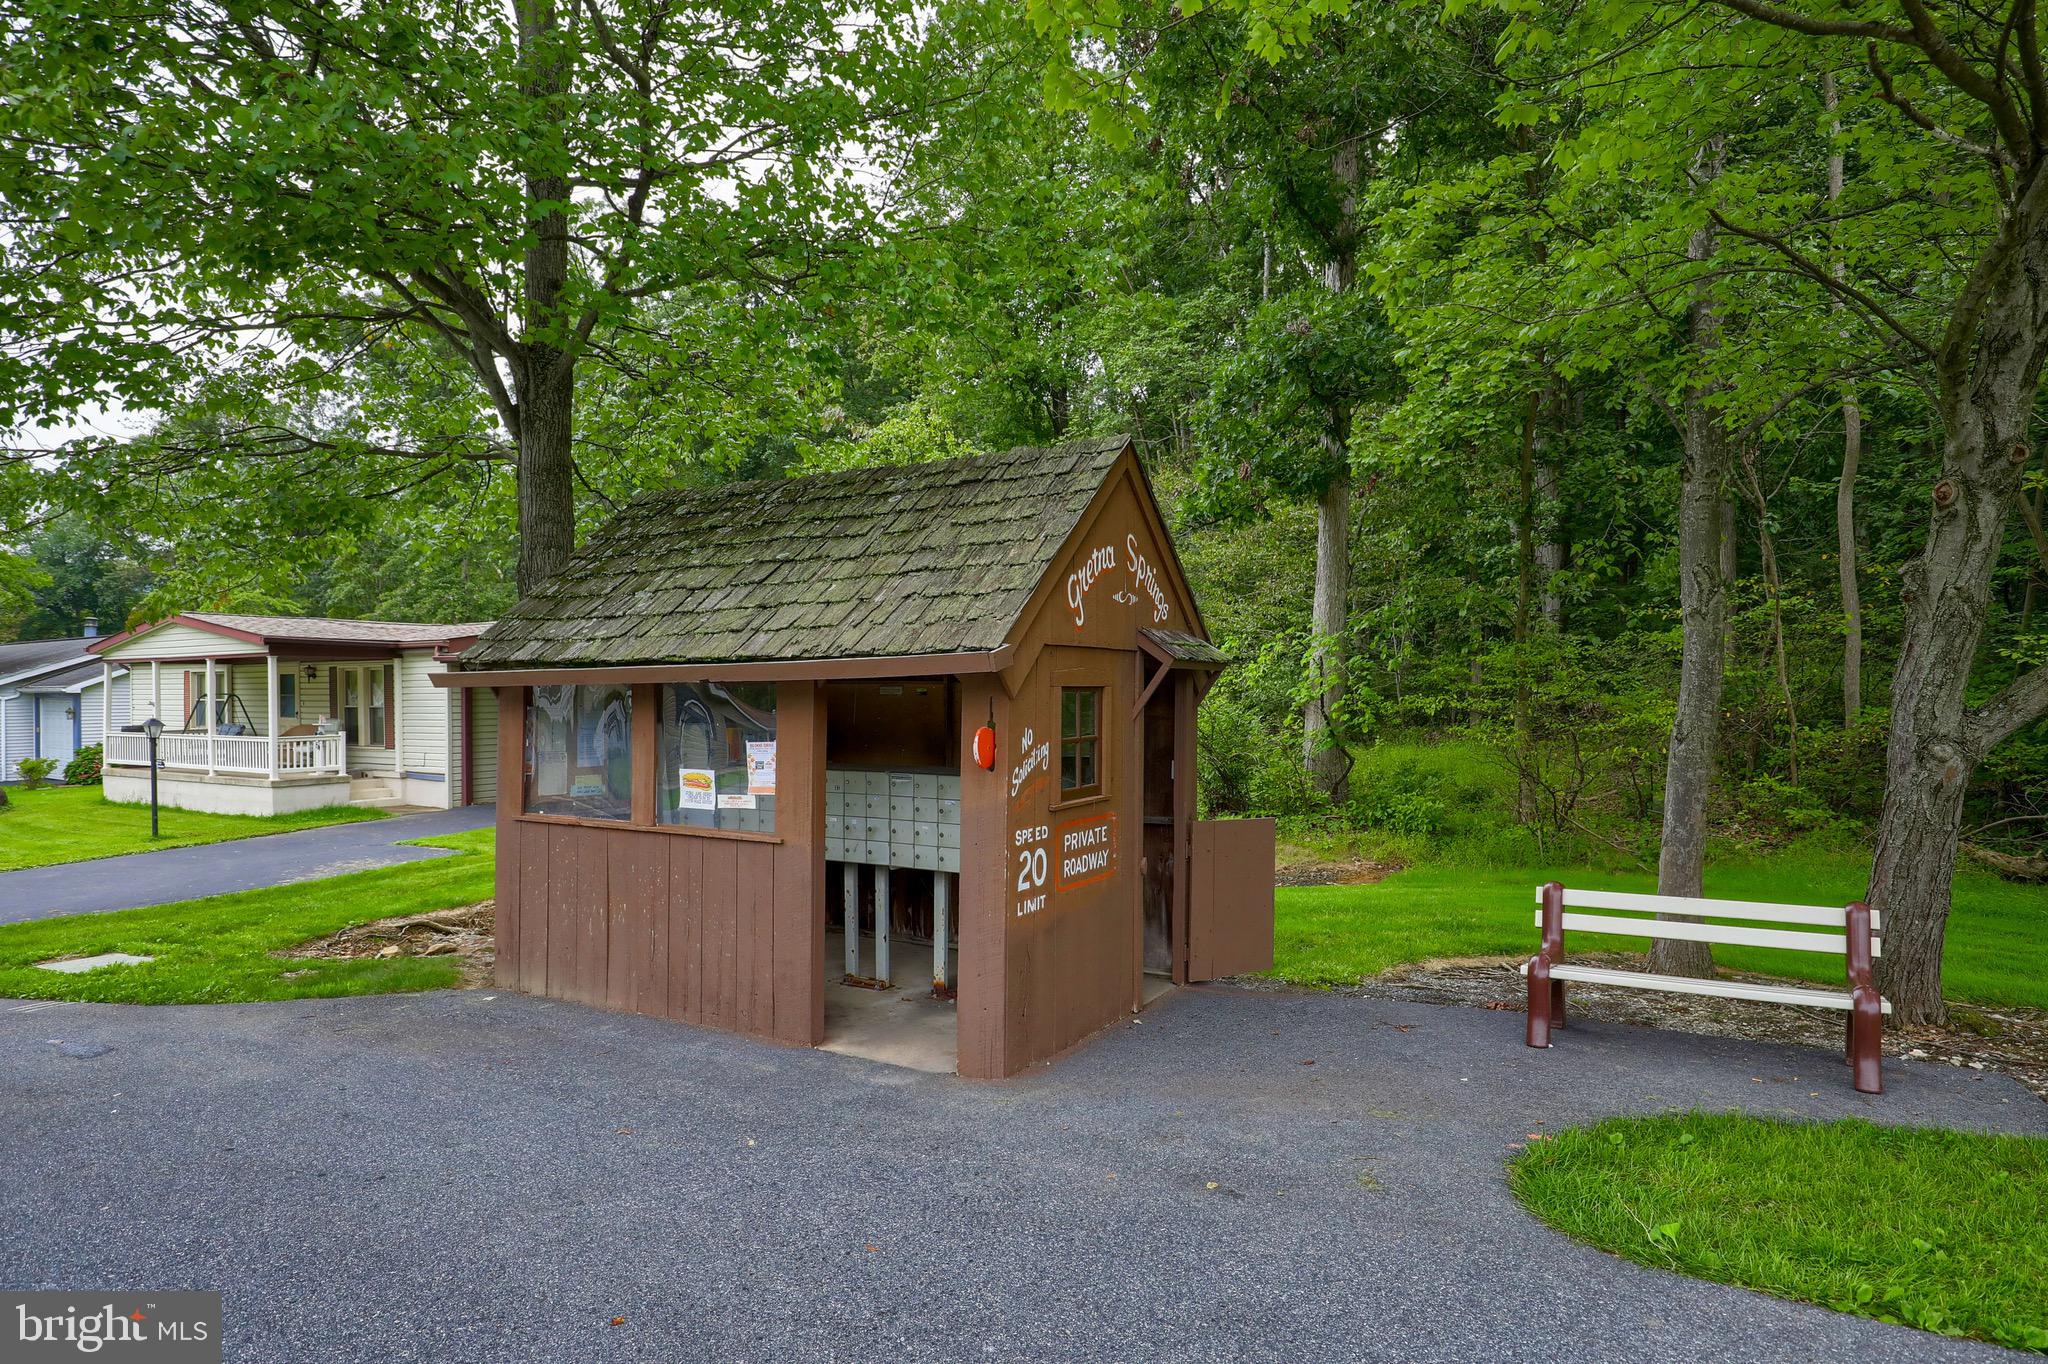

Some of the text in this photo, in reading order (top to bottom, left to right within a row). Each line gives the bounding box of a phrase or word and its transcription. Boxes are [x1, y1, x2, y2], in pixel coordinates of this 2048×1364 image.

[1067, 533, 1169, 626] Gretna Springs
[1015, 825, 1049, 846] SPEED
[1064, 825, 1108, 853] PRIVATE
[1017, 847, 1048, 892] 20
[1063, 848, 1110, 878] ROADWAY
[1017, 894, 1046, 917] LIMIT
